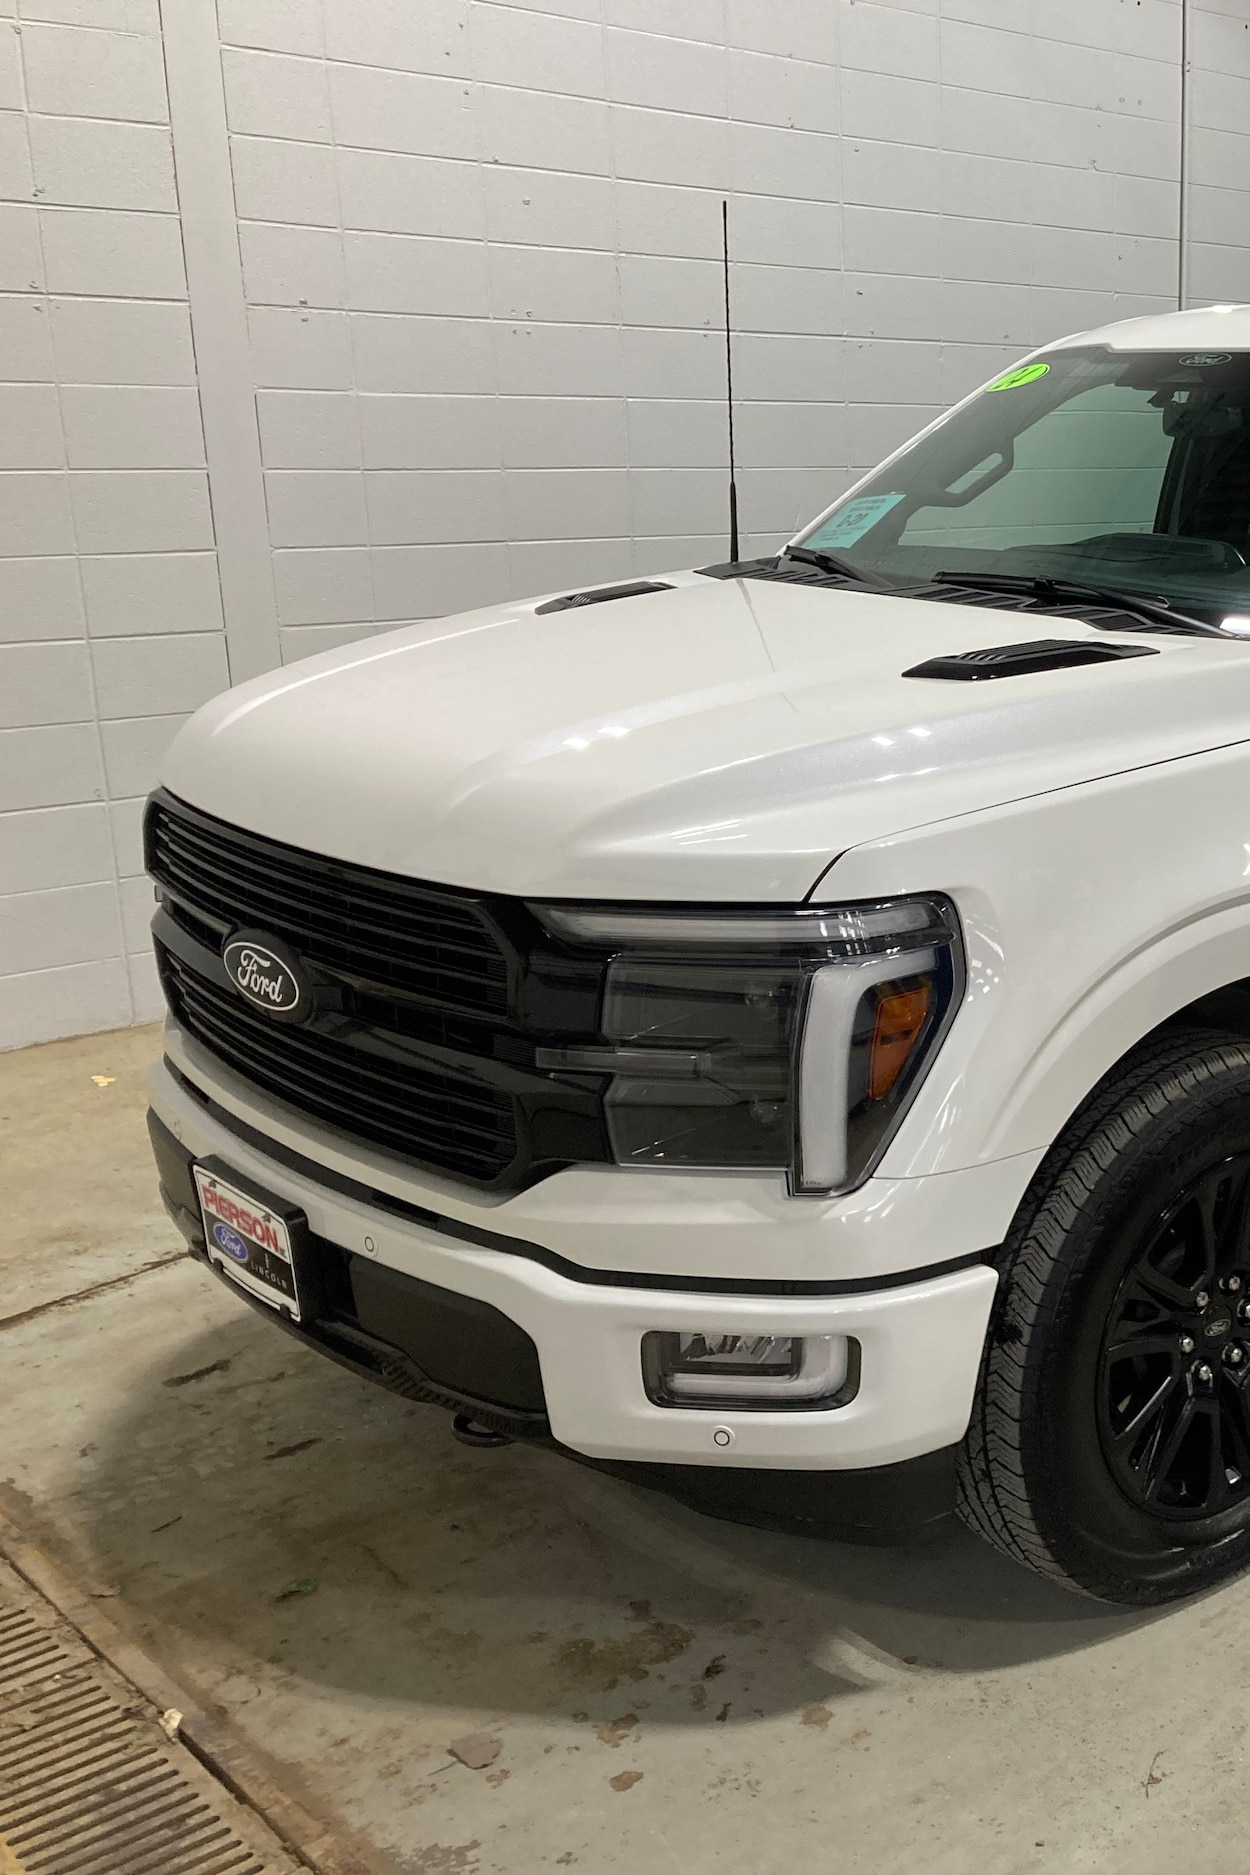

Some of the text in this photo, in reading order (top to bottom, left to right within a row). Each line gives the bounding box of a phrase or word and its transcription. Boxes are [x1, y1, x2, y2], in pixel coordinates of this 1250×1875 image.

[237, 949, 283, 1003] Ford
[201, 1183, 280, 1254] PIERSON
[219, 1227, 243, 1257] Ford
[250, 1261, 288, 1289] LINCOLN
